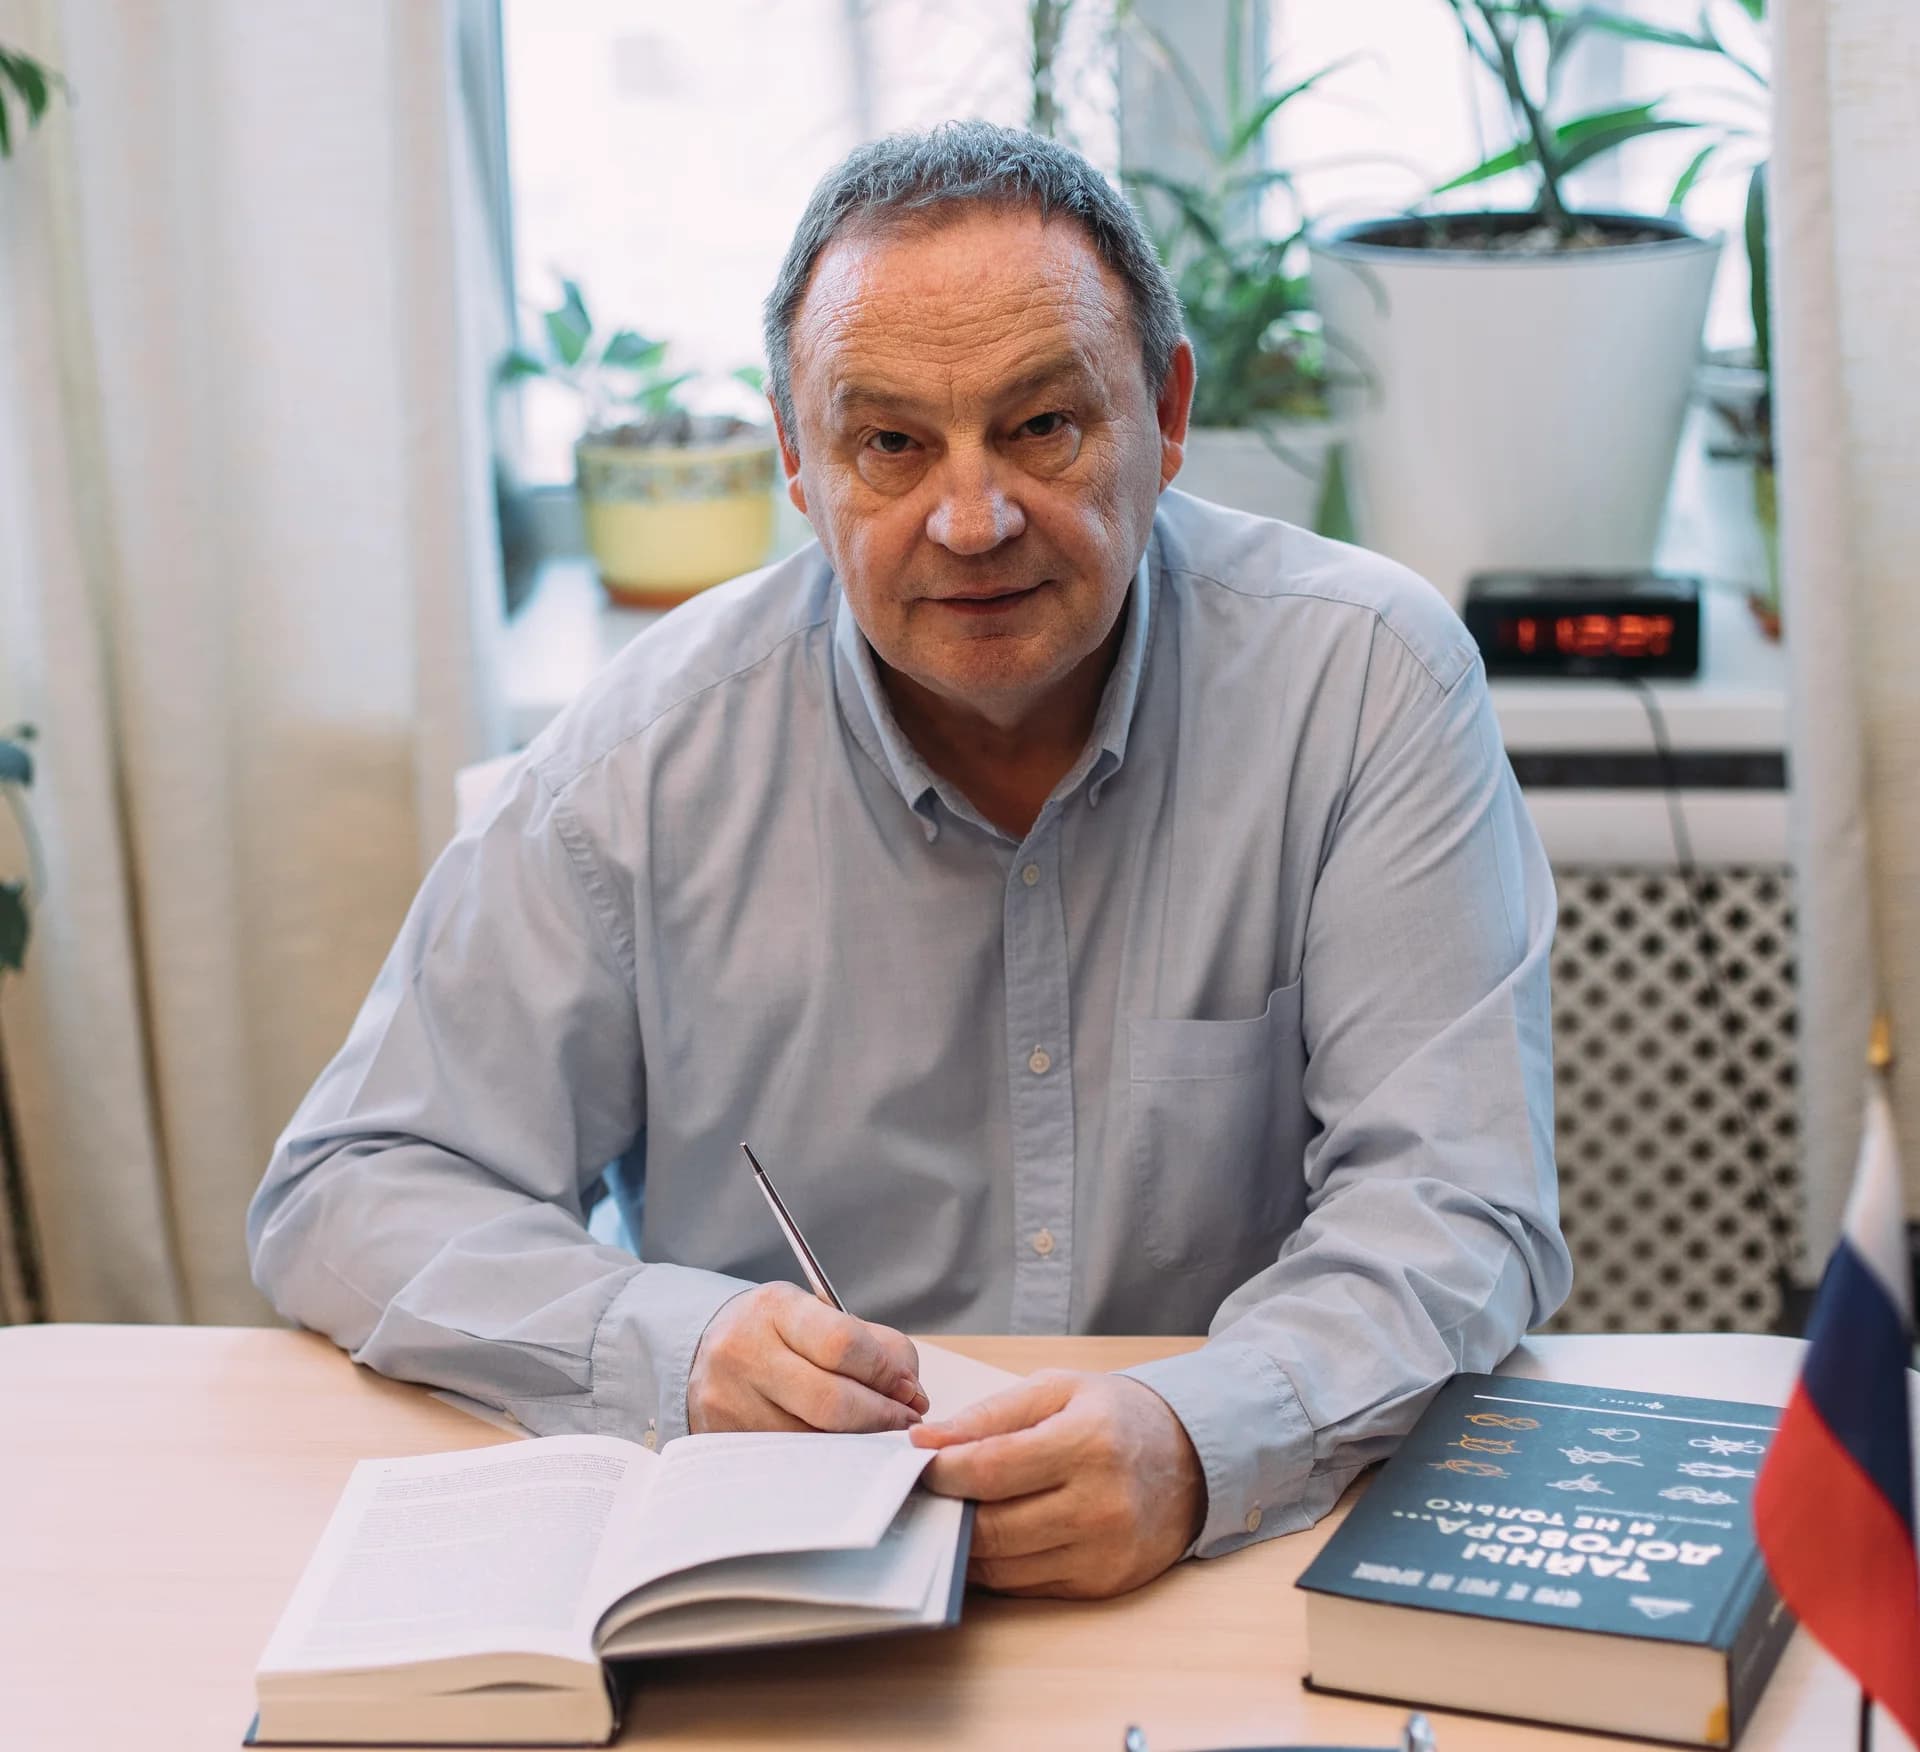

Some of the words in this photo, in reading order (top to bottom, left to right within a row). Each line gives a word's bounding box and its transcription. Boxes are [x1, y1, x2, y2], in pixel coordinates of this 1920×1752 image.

[1425, 1498, 1566, 1527] ТОЛЬКО
[1573, 1514, 1622, 1533] НЕ
[1391, 1511, 1724, 1566] ДОГОВОРА...
[1628, 1521, 1657, 1536] И
[1461, 1541, 1651, 1582] ТАЙНЫ
